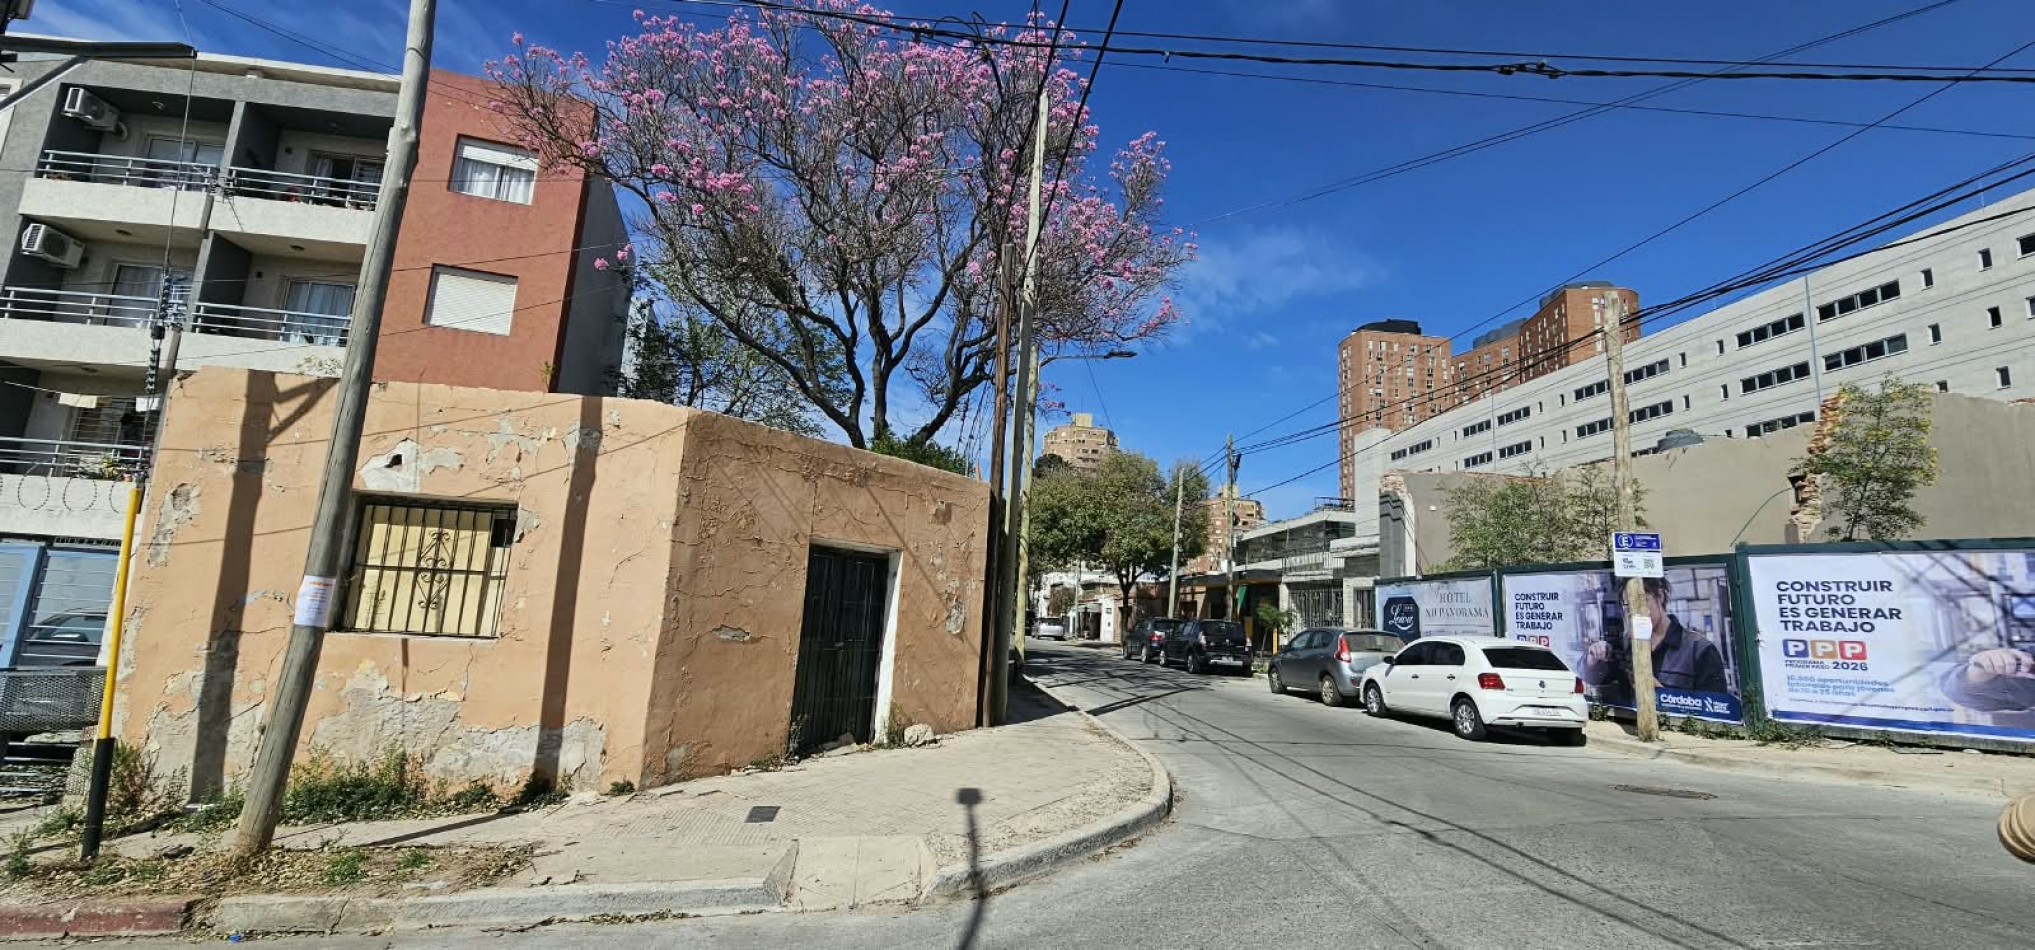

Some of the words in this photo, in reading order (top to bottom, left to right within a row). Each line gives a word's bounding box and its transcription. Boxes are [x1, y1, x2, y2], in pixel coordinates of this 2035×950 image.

[1776, 580, 1893, 592] CONSTRUIR
[1439, 592, 1470, 603] HOTEL
[1515, 592, 1559, 601] CONSTRUIR
[1777, 594, 1856, 605] FUTURO
[1515, 602, 1545, 610] FUTURO
[1439, 607, 1489, 618] PANORAMA
[1515, 611, 1524, 620] ES
[1525, 611, 1563, 621] GENERAR
[1780, 607, 1801, 618] ES
[1804, 607, 1902, 620] GENERAR
[1515, 621, 1553, 630] TRABAJO
[1780, 620, 1876, 633] TRABAJO
[1832, 661, 1868, 671] 2026
[1660, 693, 1702, 707] Córdoba
